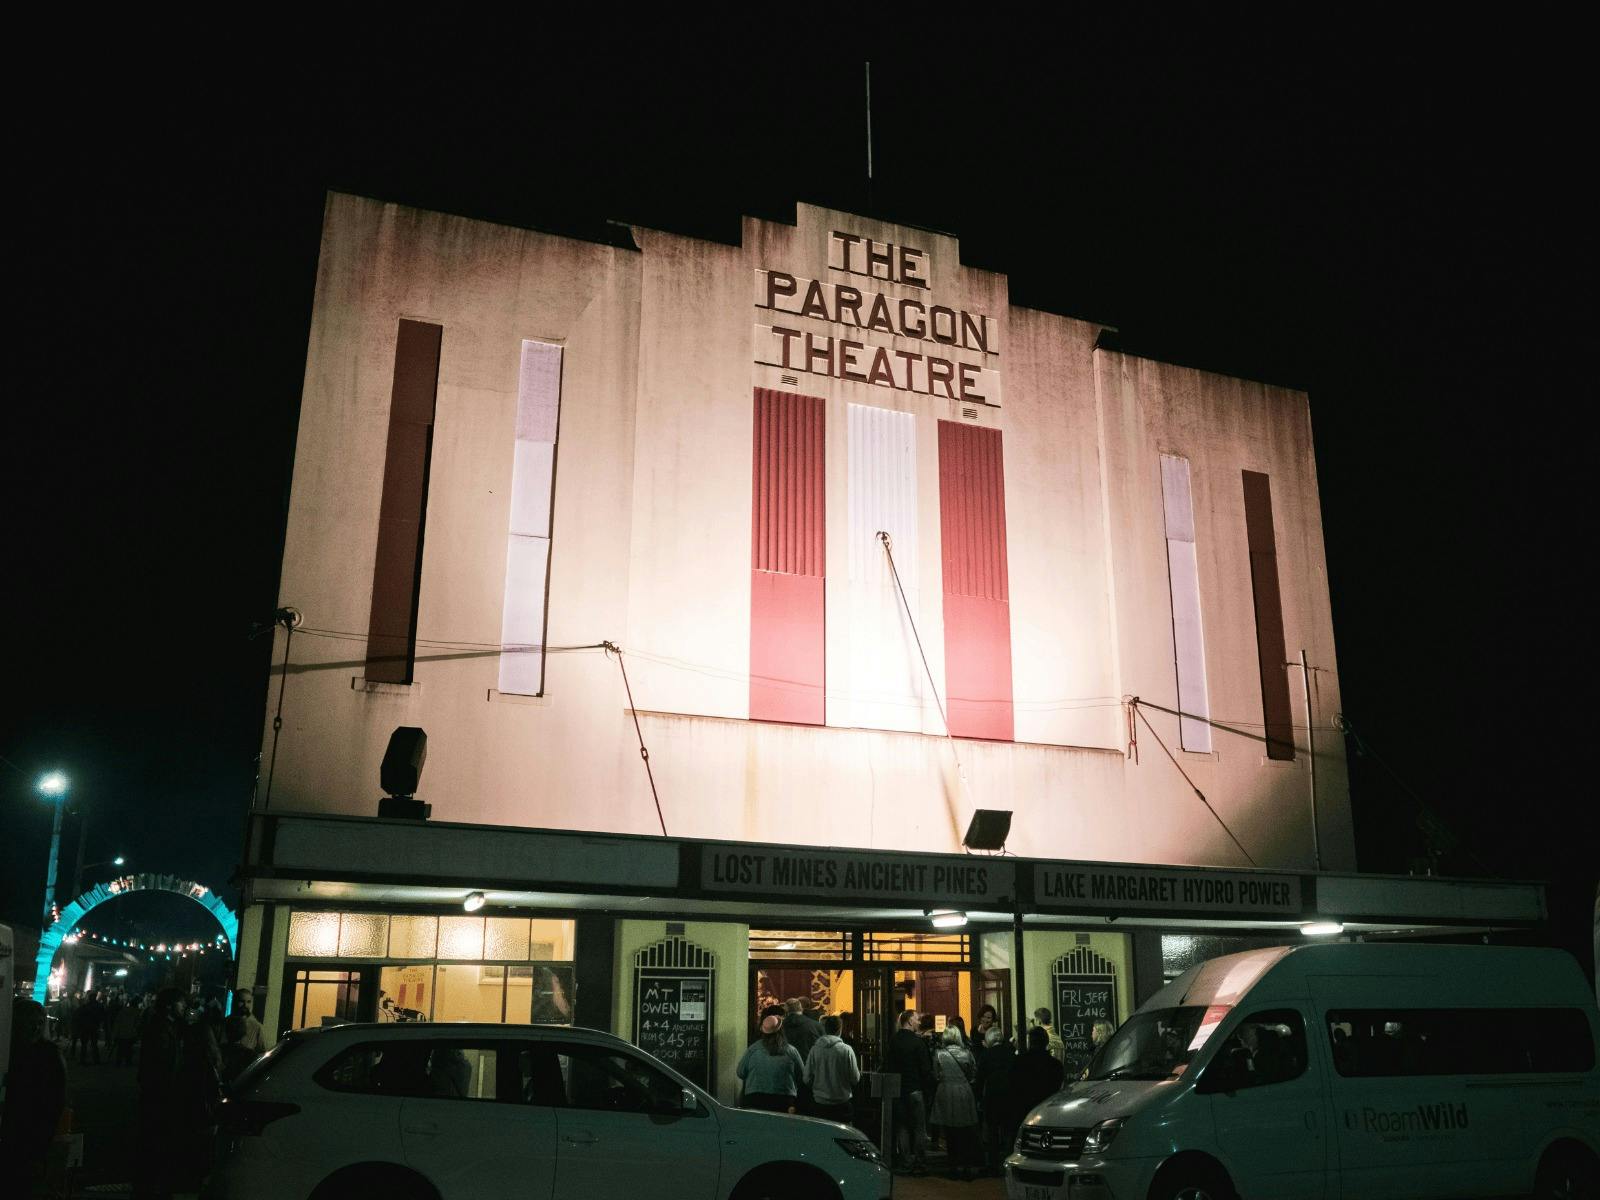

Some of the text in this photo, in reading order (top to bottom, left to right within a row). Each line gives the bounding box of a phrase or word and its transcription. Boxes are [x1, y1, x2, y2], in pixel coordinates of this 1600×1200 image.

[833, 230, 926, 289] THE
[767, 270, 988, 352] PARAGON
[772, 326, 986, 404] THEATRE
[714, 853, 988, 895] LOST MINES ANCIENT PINES
[1044, 872, 1290, 906] LAKE MARGARET HYDRO POWER
[645, 988, 674, 1000] MT
[1062, 989, 1109, 1005] FRI JEFF
[641, 1002, 679, 1015] OWEN
[1077, 1007, 1106, 1017] LANG
[1062, 1023, 1084, 1038] SAT
[658, 1032, 685, 1047] $45
[1066, 1041, 1089, 1050] MARK
[1363, 1102, 1468, 1132] RoamWild
